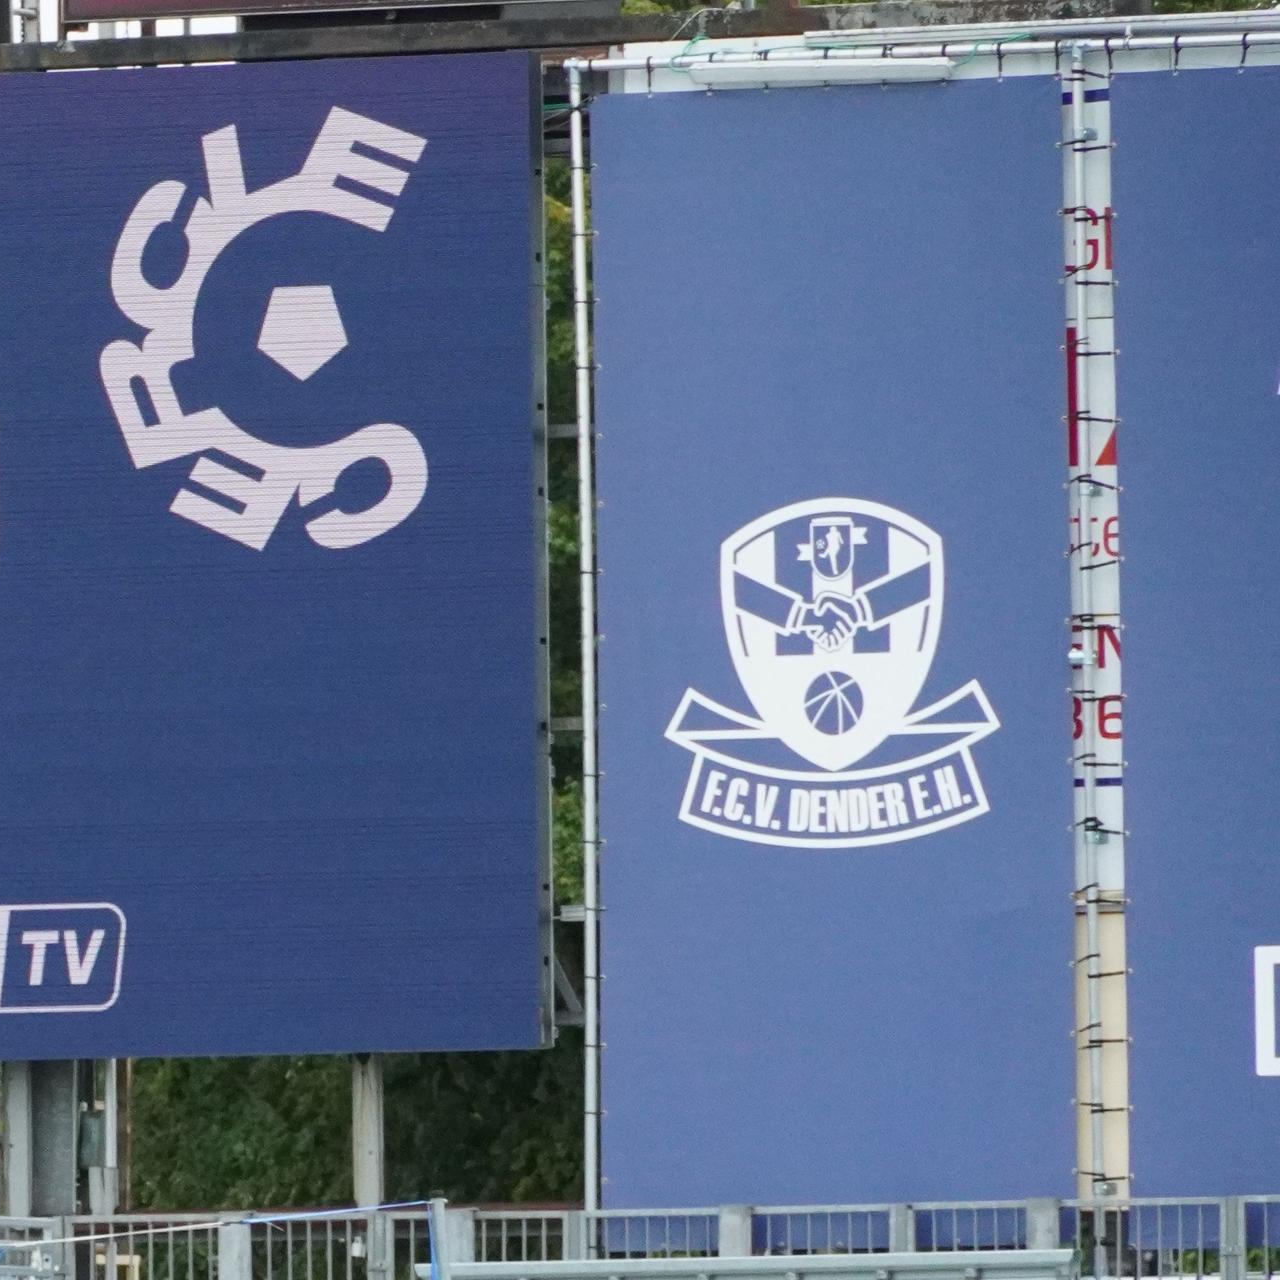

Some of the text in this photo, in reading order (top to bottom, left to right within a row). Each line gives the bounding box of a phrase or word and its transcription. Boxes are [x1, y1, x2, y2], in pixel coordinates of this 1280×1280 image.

[700, 766, 972, 833] F.C.V. DENDER E.H.
[22, 929, 106, 986] TV
